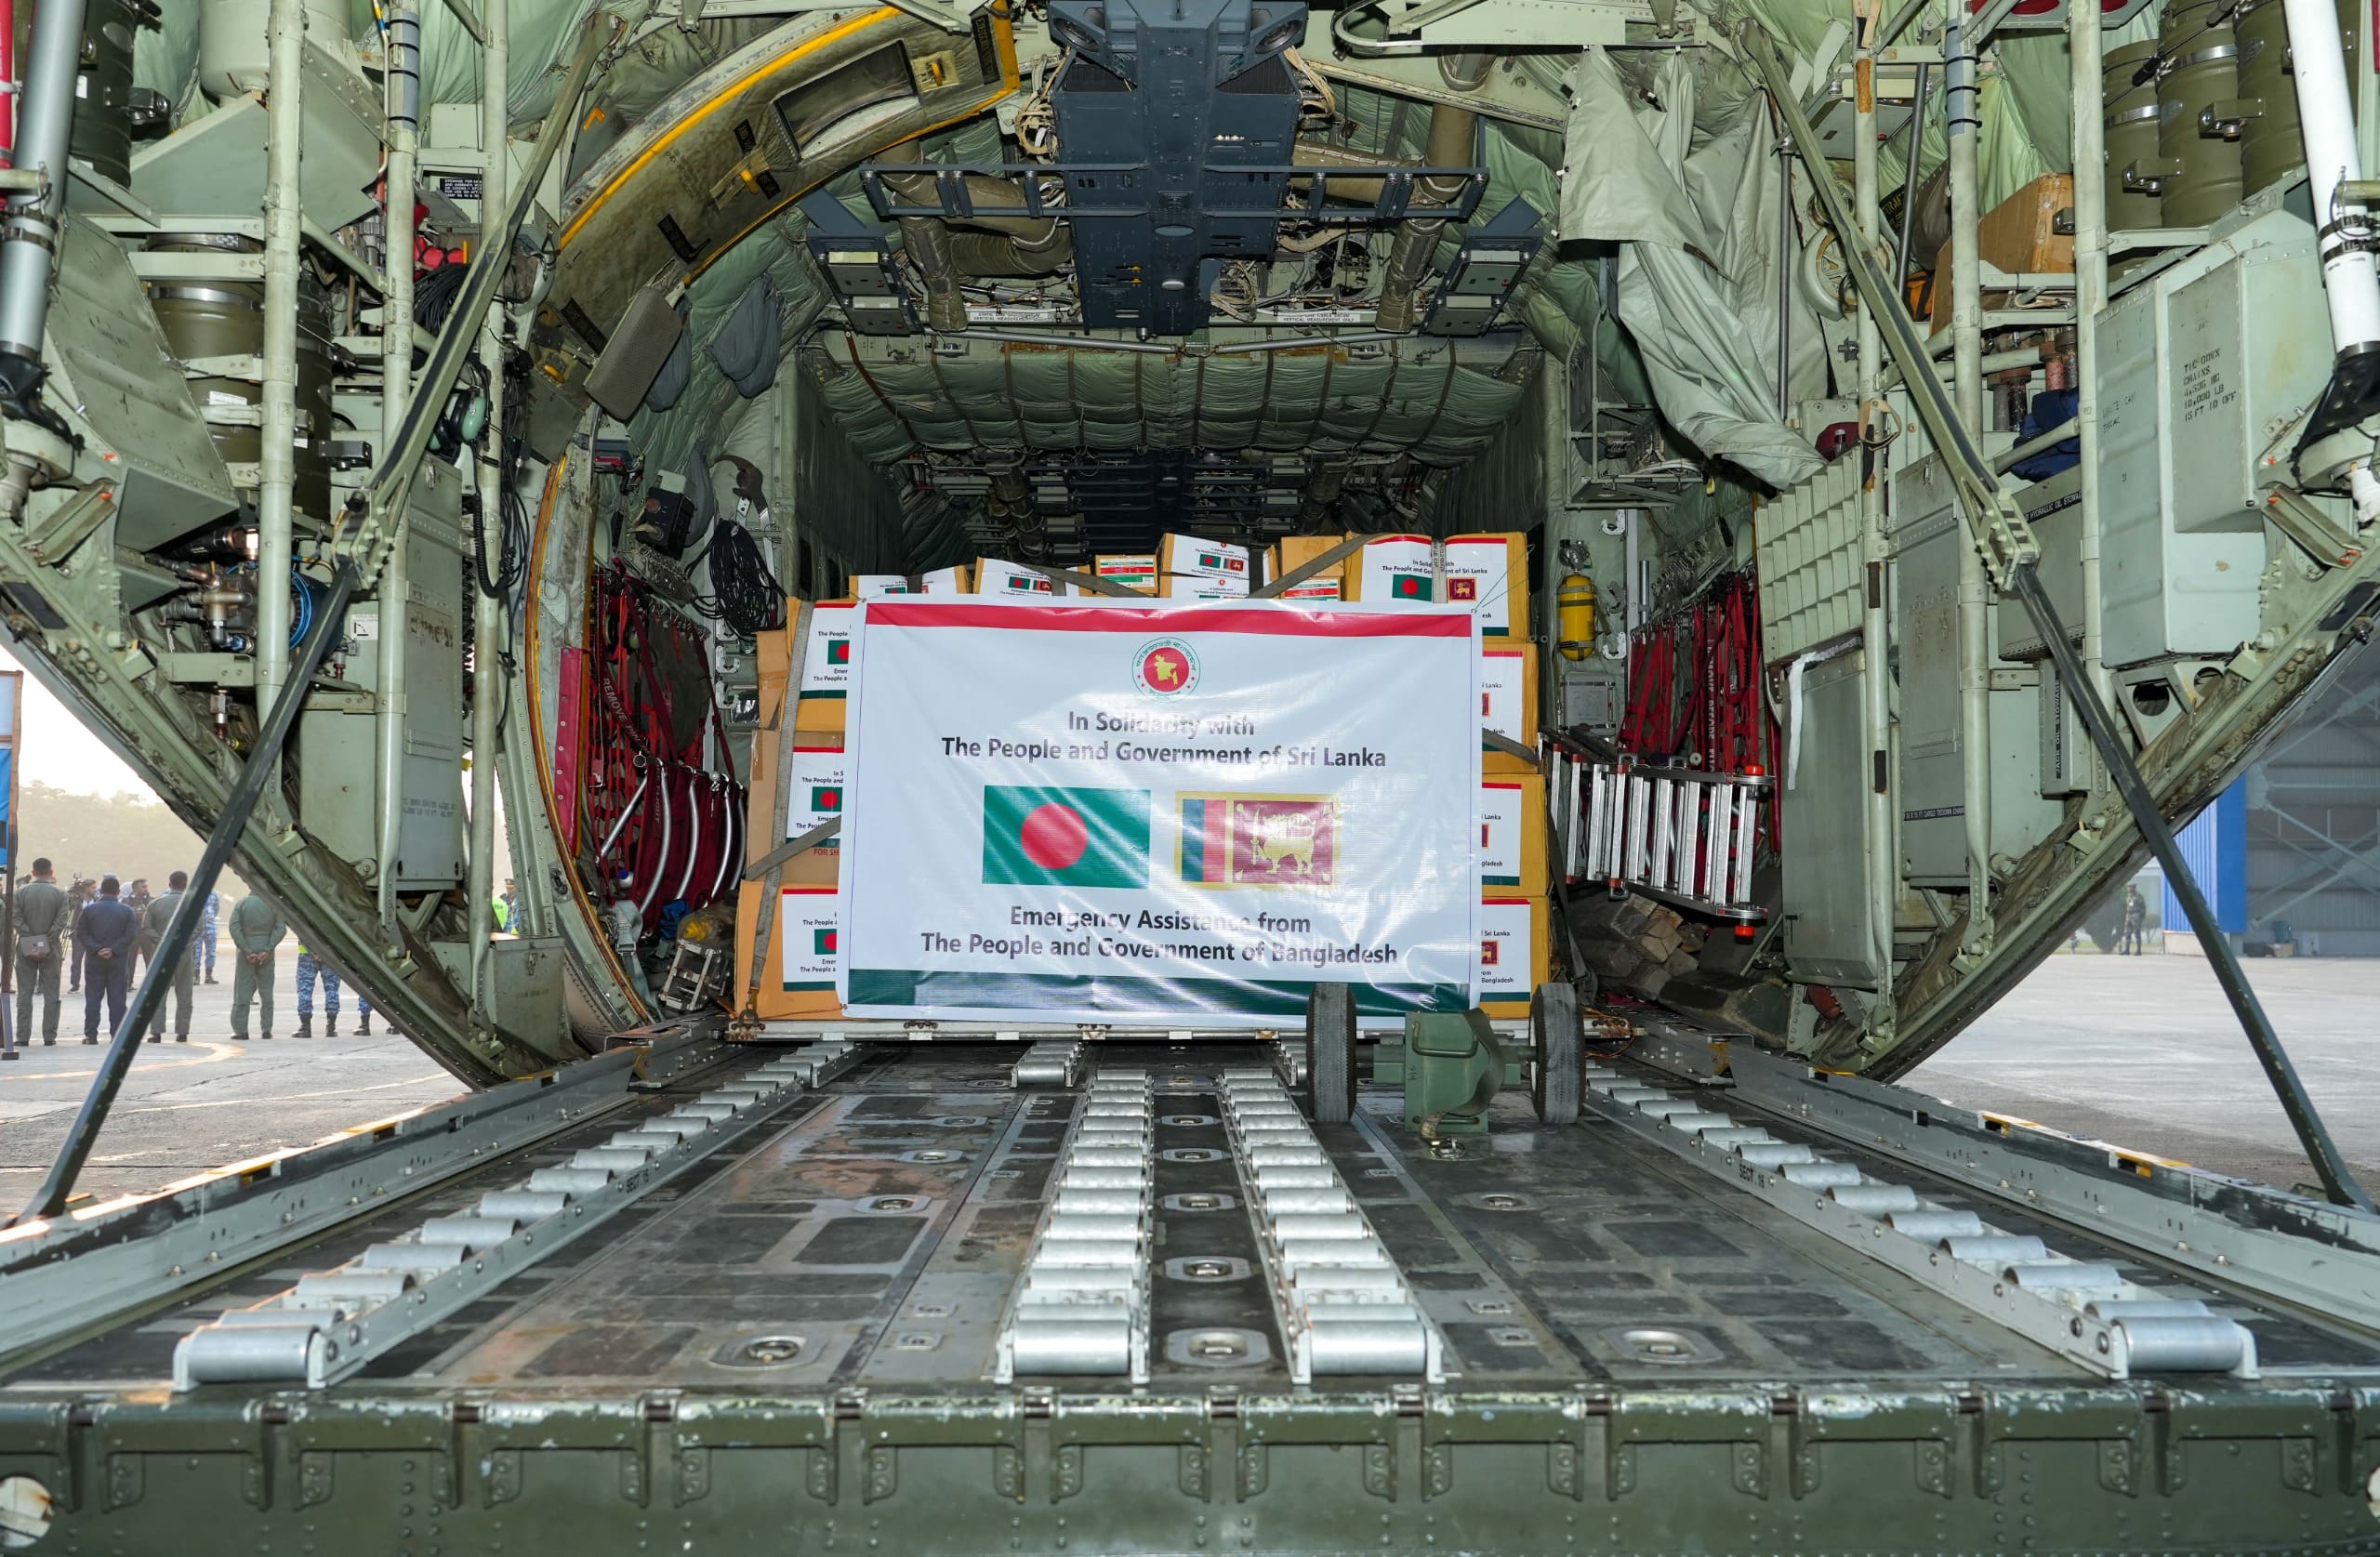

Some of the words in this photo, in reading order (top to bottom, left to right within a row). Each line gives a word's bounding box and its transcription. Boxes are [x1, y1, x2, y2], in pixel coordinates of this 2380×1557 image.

[603, 678, 628, 723] REMOVE
[1069, 711, 1089, 731] In
[1096, 712, 1200, 740] Solidarity
[1209, 715, 1255, 736] with
[941, 736, 982, 758] The
[989, 738, 1062, 764] People
[1069, 740, 1108, 760] and
[1116, 741, 1251, 765] Government
[1259, 745, 1282, 766] of
[1288, 746, 1316, 766] Sri
[1324, 746, 1386, 767] Lanka
[1011, 905, 1130, 933] Emergency
[1137, 909, 1250, 931] Assistance
[1258, 911, 1311, 933] from
[920, 931, 961, 953] The
[969, 933, 1043, 959] People
[1051, 935, 1091, 957] and
[1098, 937, 1235, 960] Government
[1242, 941, 1265, 961] of
[1272, 942, 1397, 969] Bangladesh
